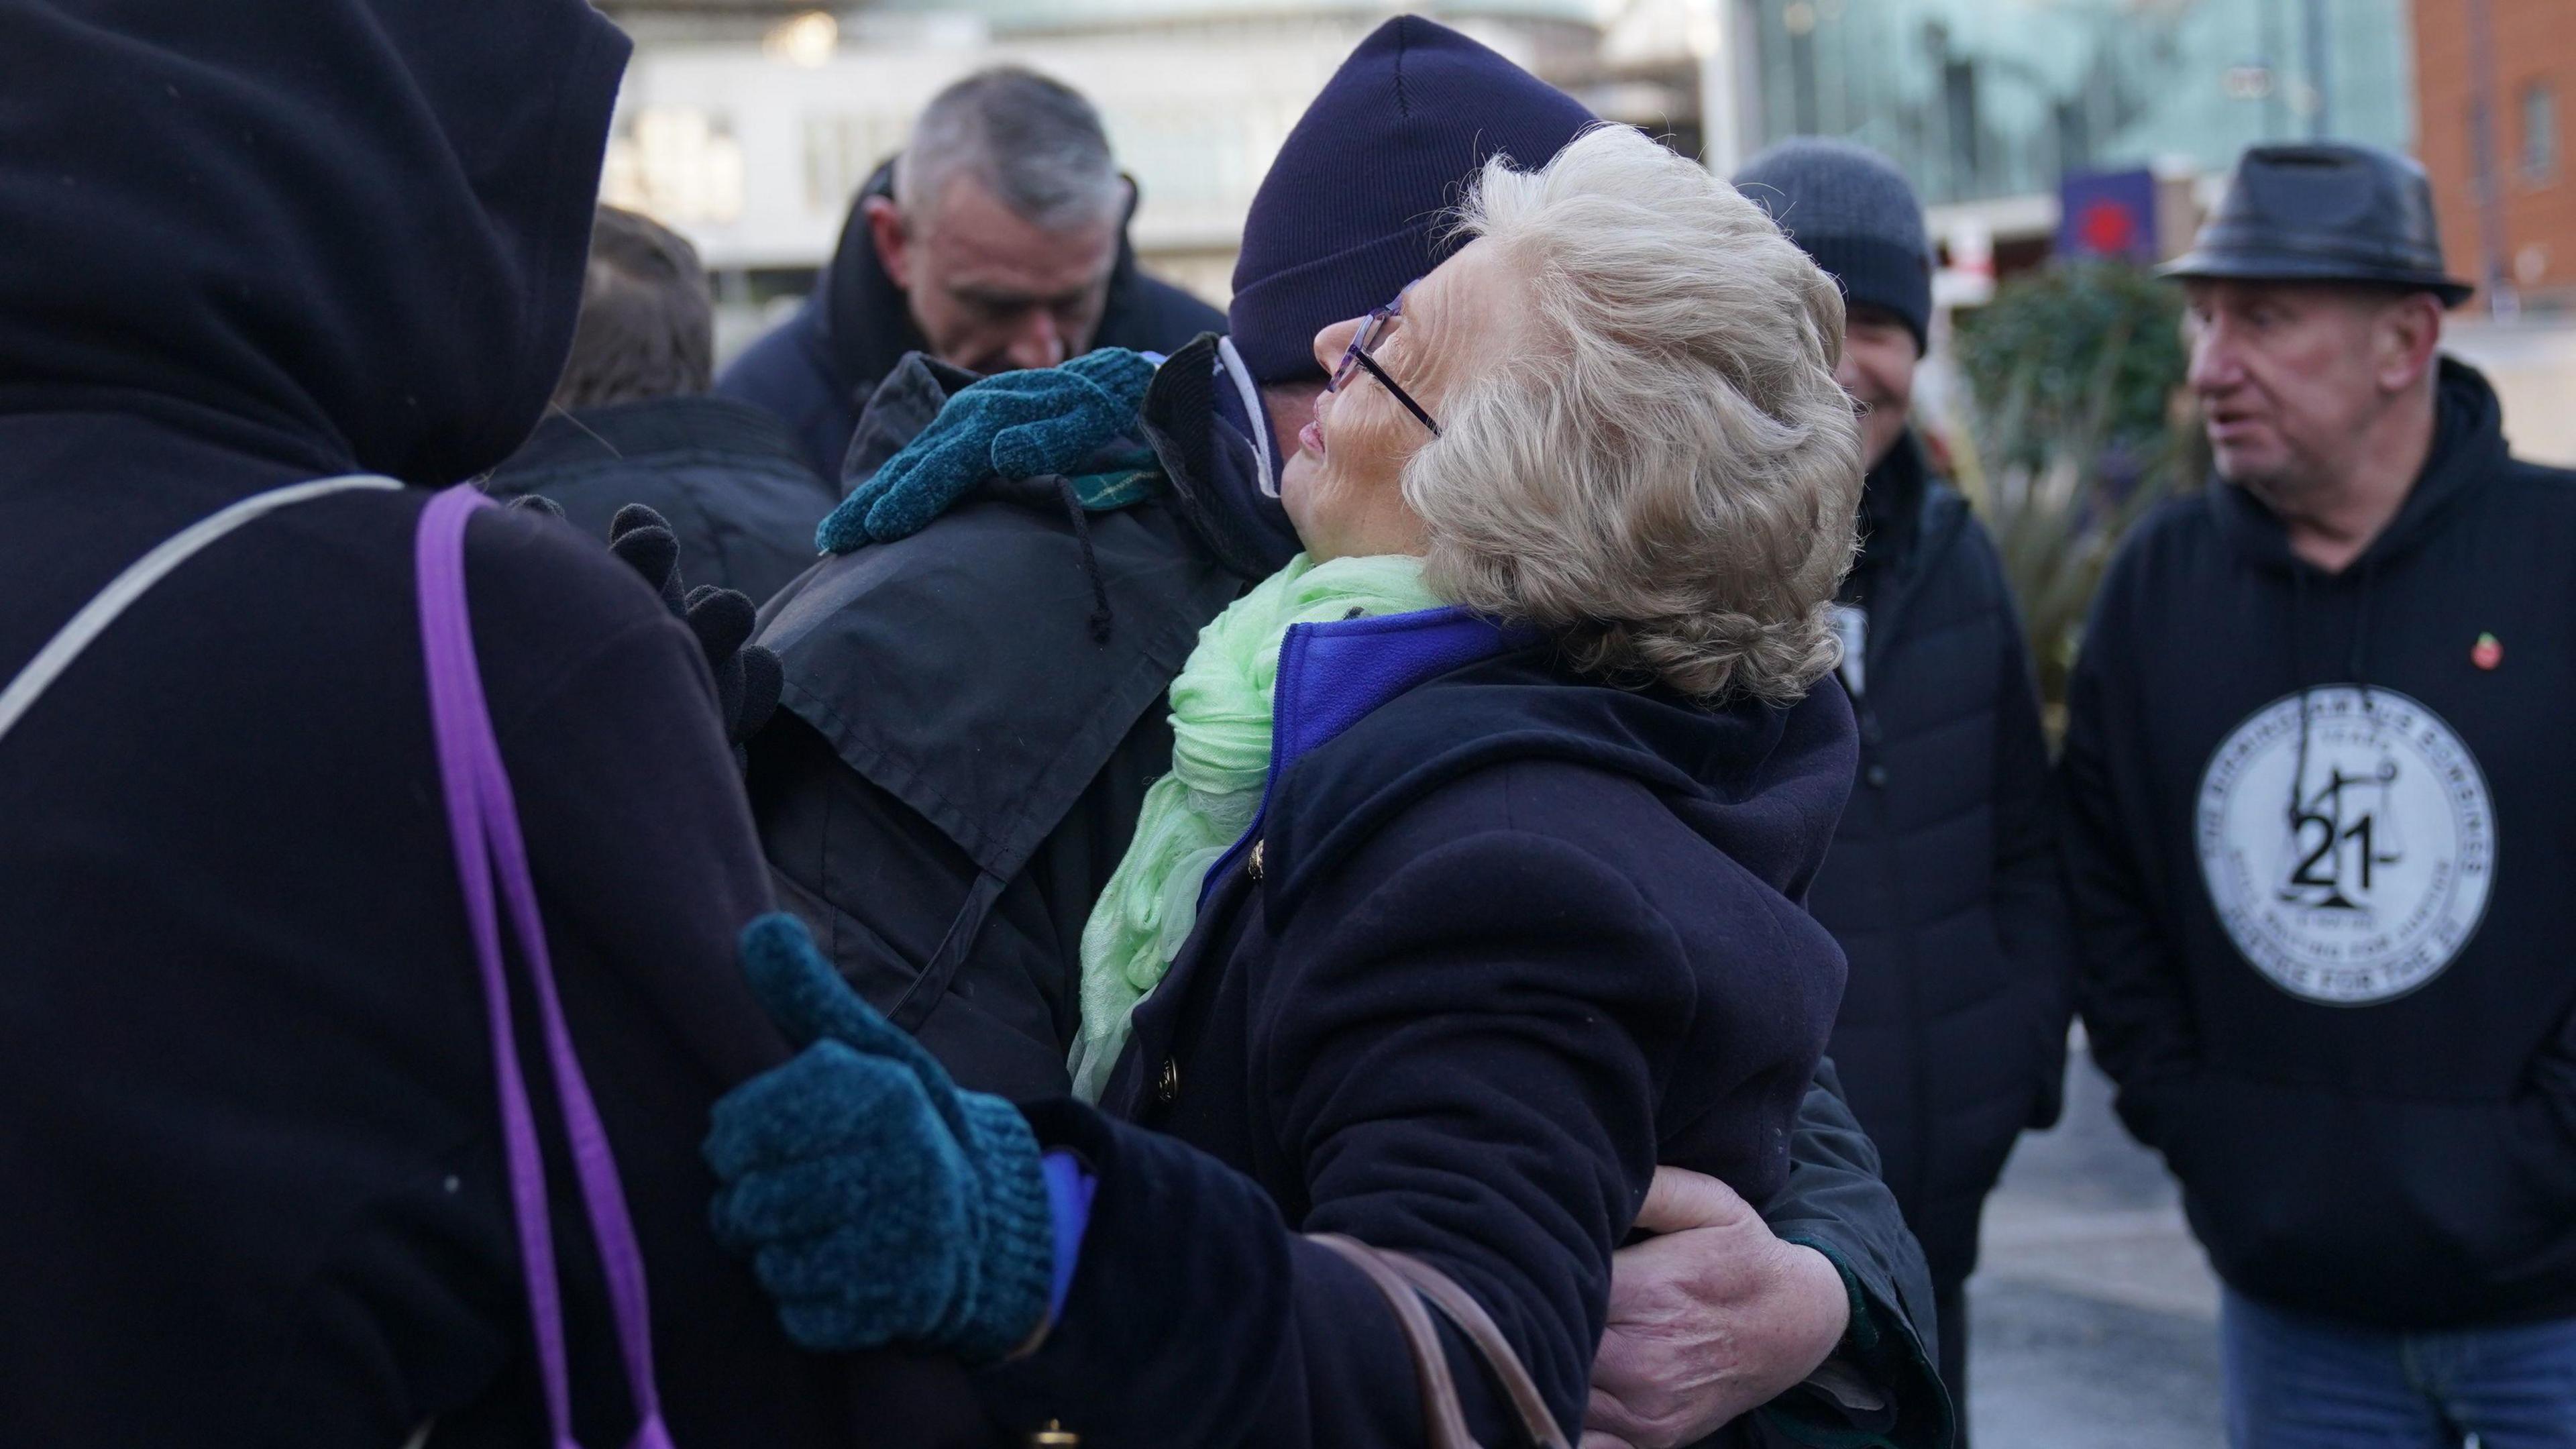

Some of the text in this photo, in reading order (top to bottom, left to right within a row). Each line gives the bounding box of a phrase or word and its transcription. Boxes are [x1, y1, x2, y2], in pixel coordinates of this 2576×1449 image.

[2416, 726, 2486, 875] BOMBINGS
[2290, 814, 2372, 888] 21
[2321, 965, 2374, 991] FOR
